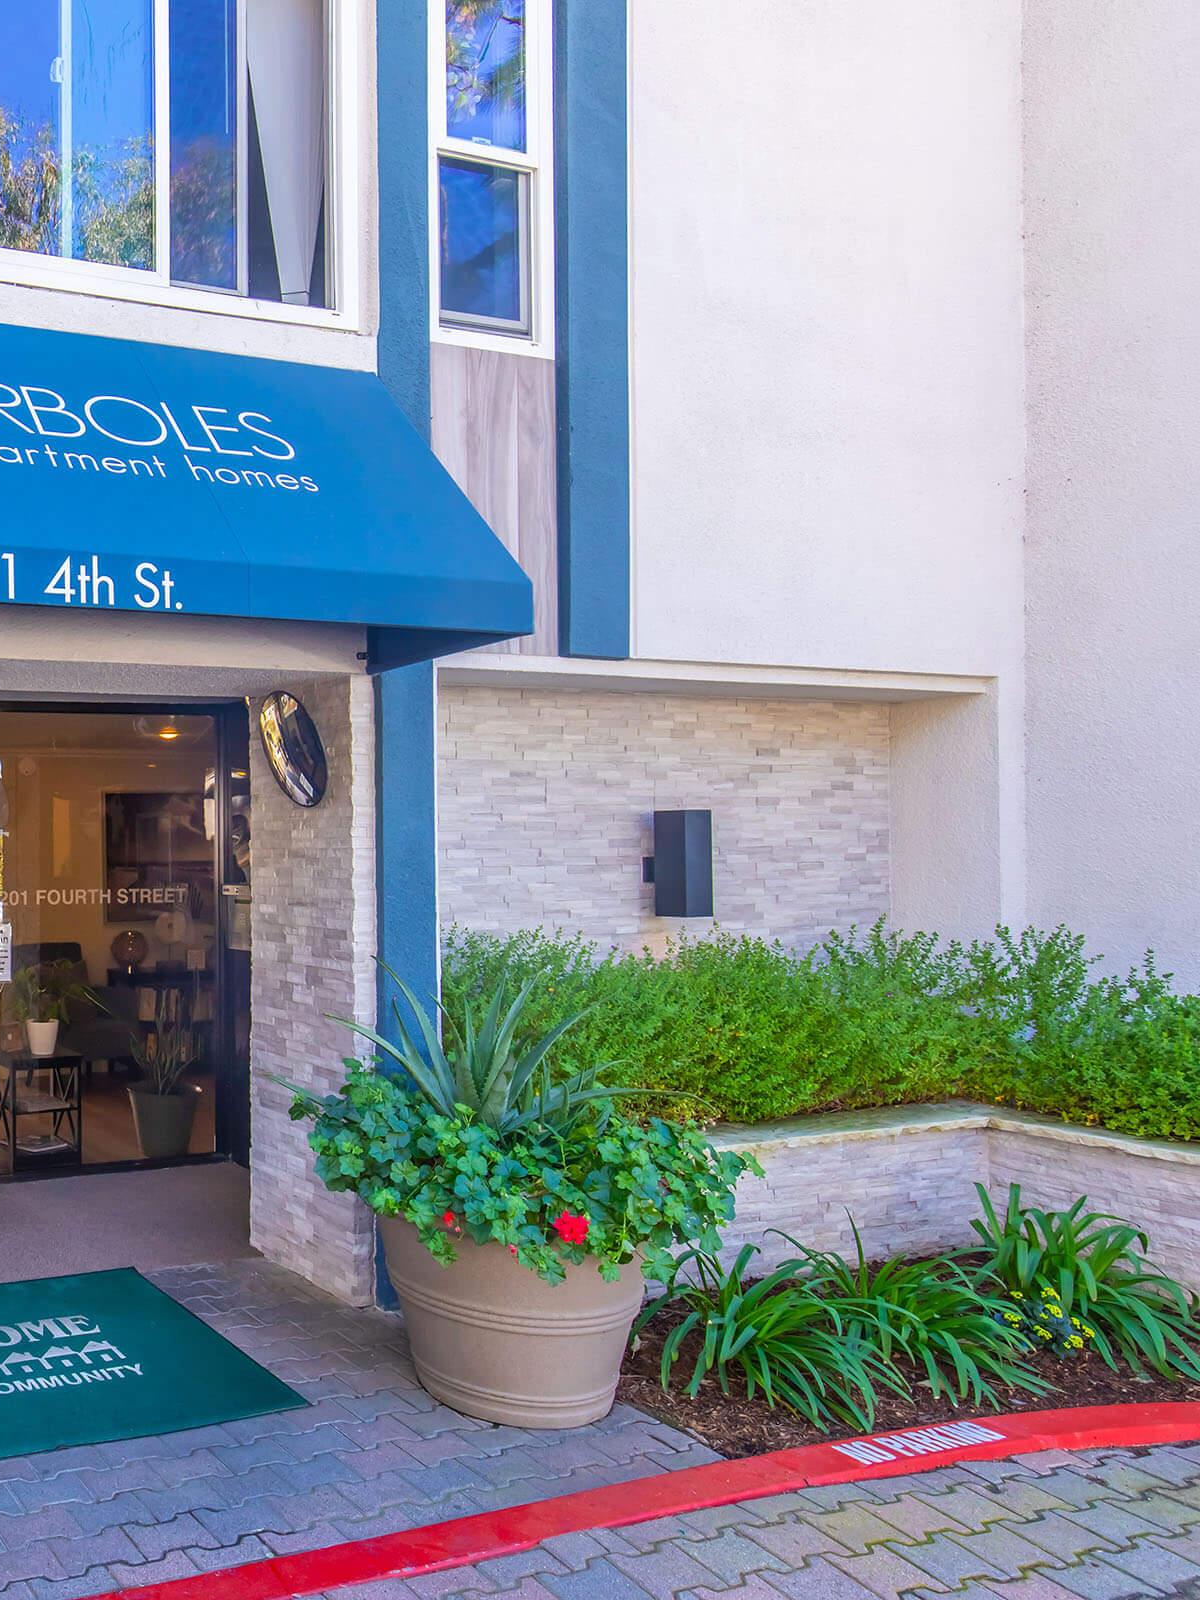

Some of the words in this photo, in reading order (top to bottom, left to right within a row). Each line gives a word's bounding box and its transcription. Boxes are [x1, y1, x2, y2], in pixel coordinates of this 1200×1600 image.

[184, 454, 320, 492] homes
[44, 555, 116, 605] 4th
[133, 562, 183, 610] St.
[0, 890, 27, 906] 201
[36, 889, 111, 905] FOURTH
[117, 887, 186, 904] STREET
[832, 1441, 896, 1465] NO
[872, 1421, 1007, 1457] PARKING
